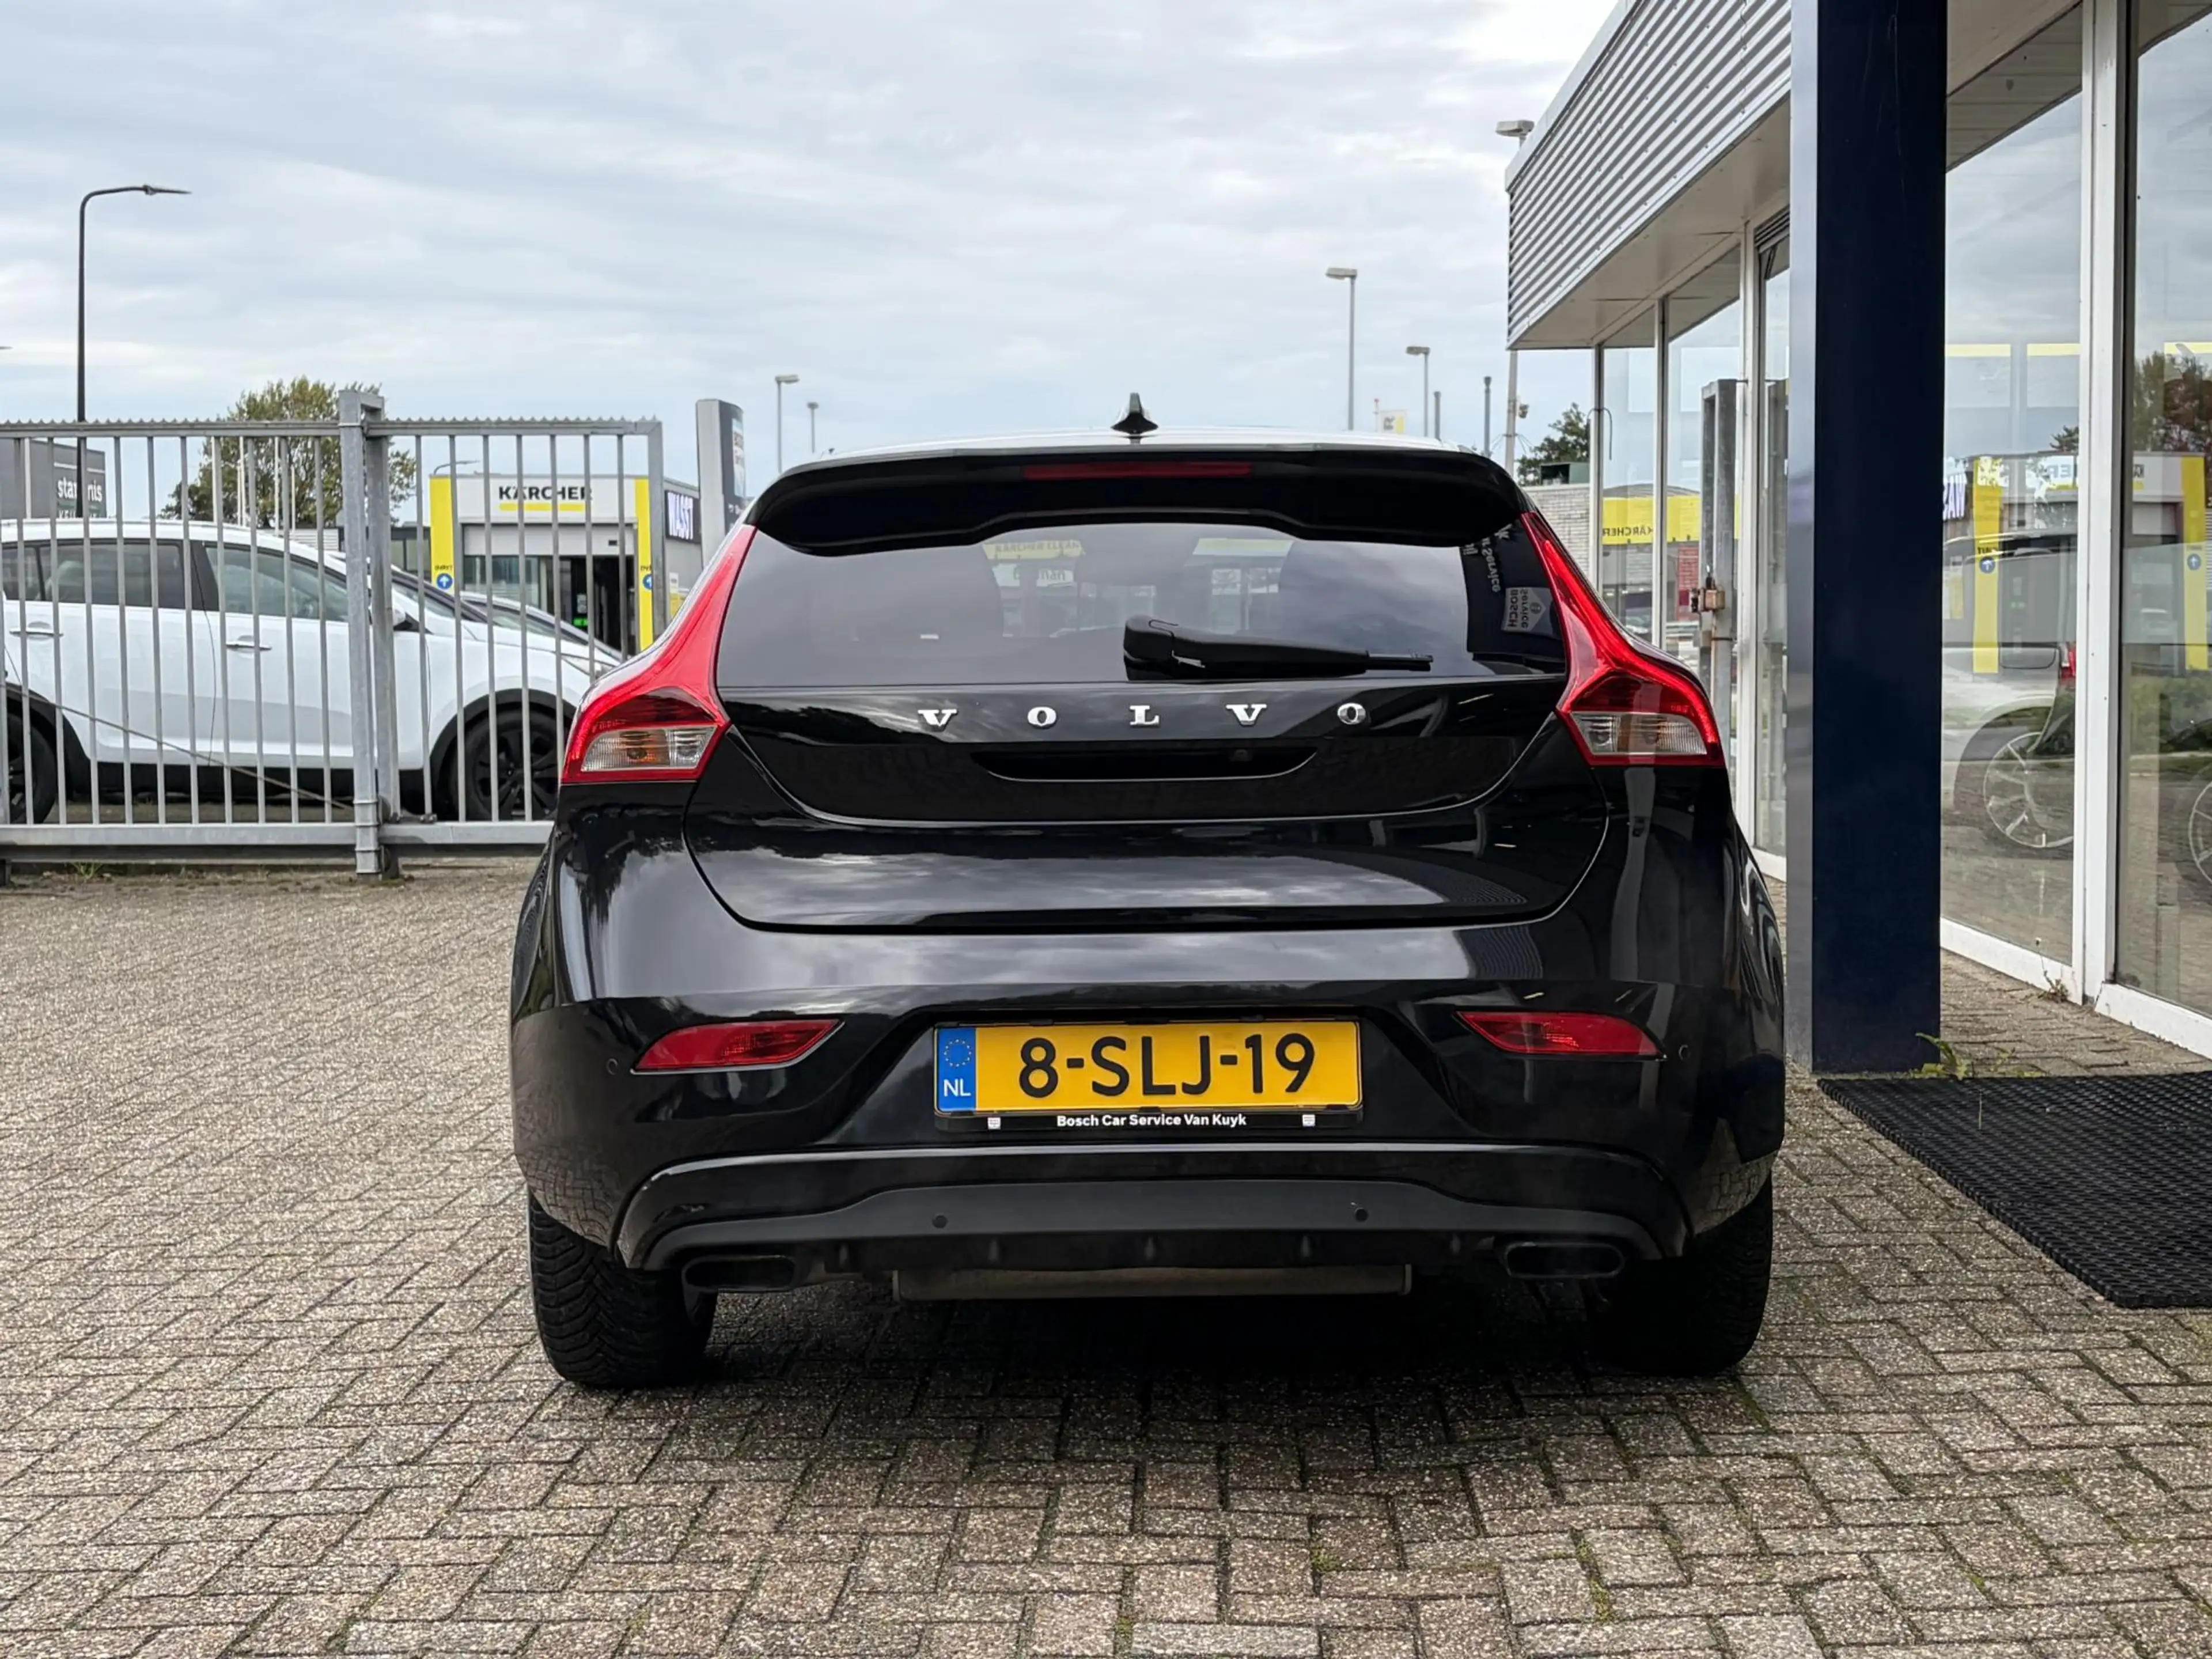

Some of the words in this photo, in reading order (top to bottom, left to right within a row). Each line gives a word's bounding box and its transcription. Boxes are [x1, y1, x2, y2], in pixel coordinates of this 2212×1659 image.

[918, 702, 1367, 729] VOLVO
[1018, 1033, 1316, 1099] 8-SLJ-19
[944, 1078, 971, 1097] NL
[1056, 1115, 1099, 1127] Bosch
[1101, 1115, 1127, 1127] Car
[1128, 1113, 1182, 1126] Service
[1184, 1113, 1210, 1126] Van
[1211, 1113, 1247, 1128] Kuyk
